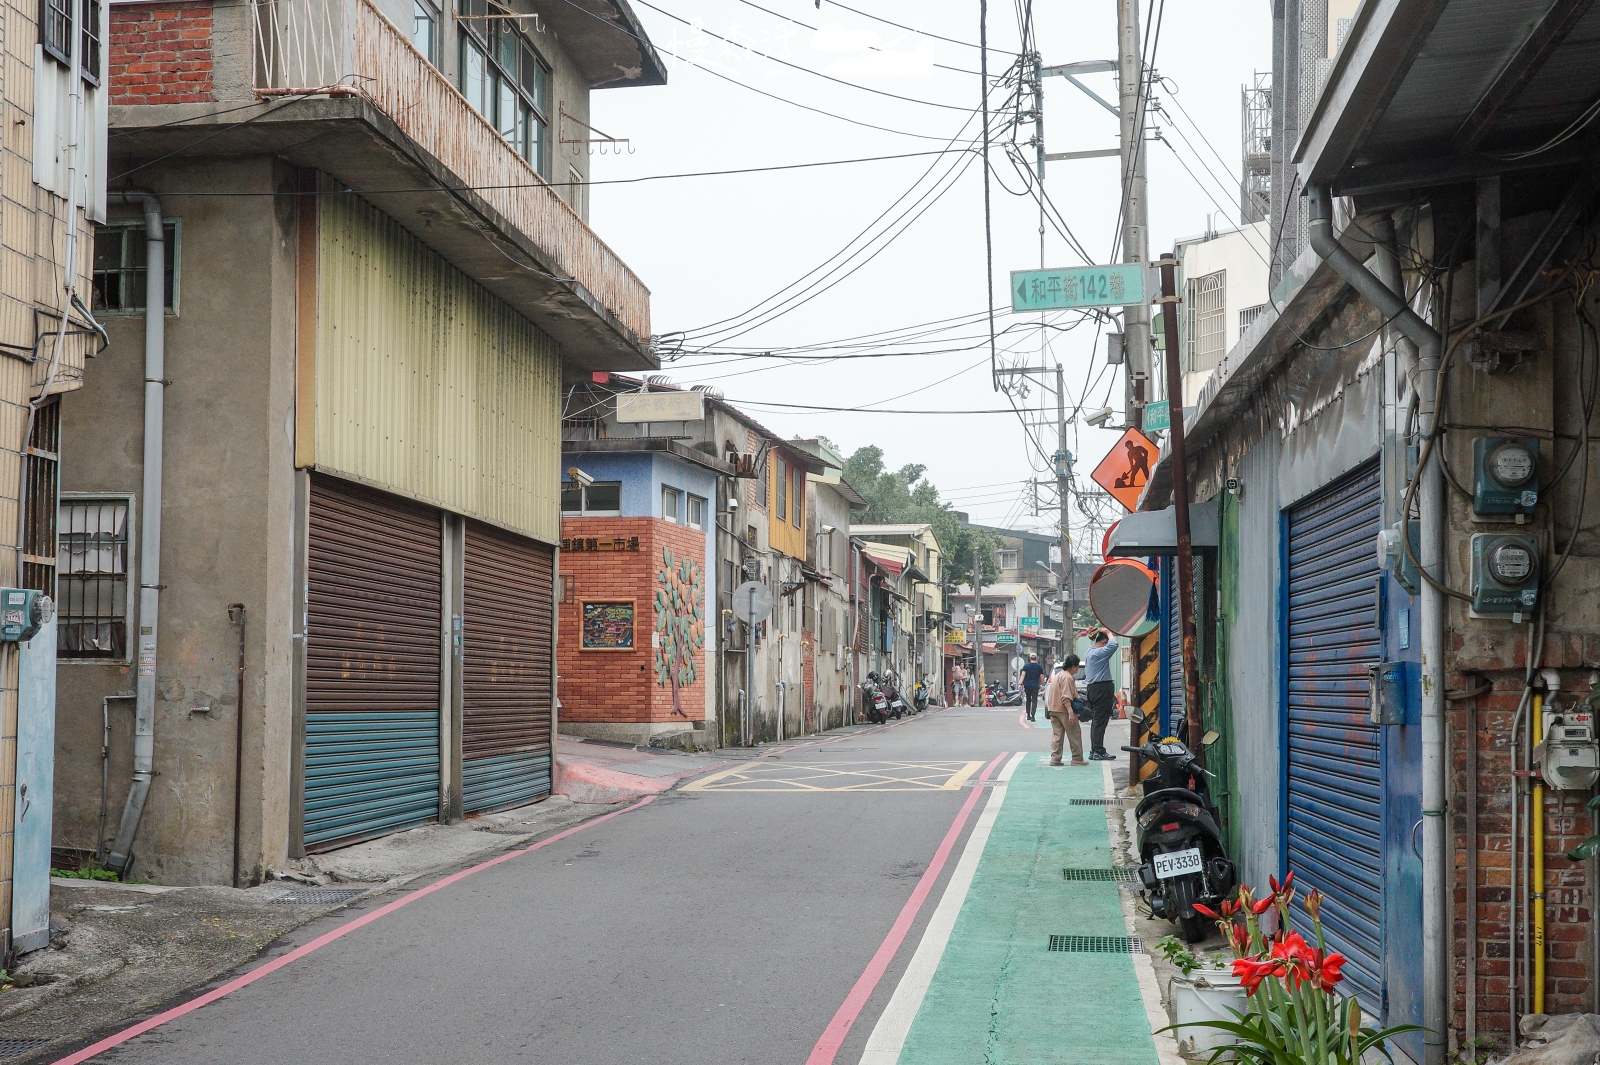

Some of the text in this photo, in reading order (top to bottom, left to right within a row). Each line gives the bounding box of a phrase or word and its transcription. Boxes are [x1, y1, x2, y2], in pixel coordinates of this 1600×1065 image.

[1030, 272, 1125, 304] 和平街142巷
[1156, 854, 1200, 874] PEV-3338
